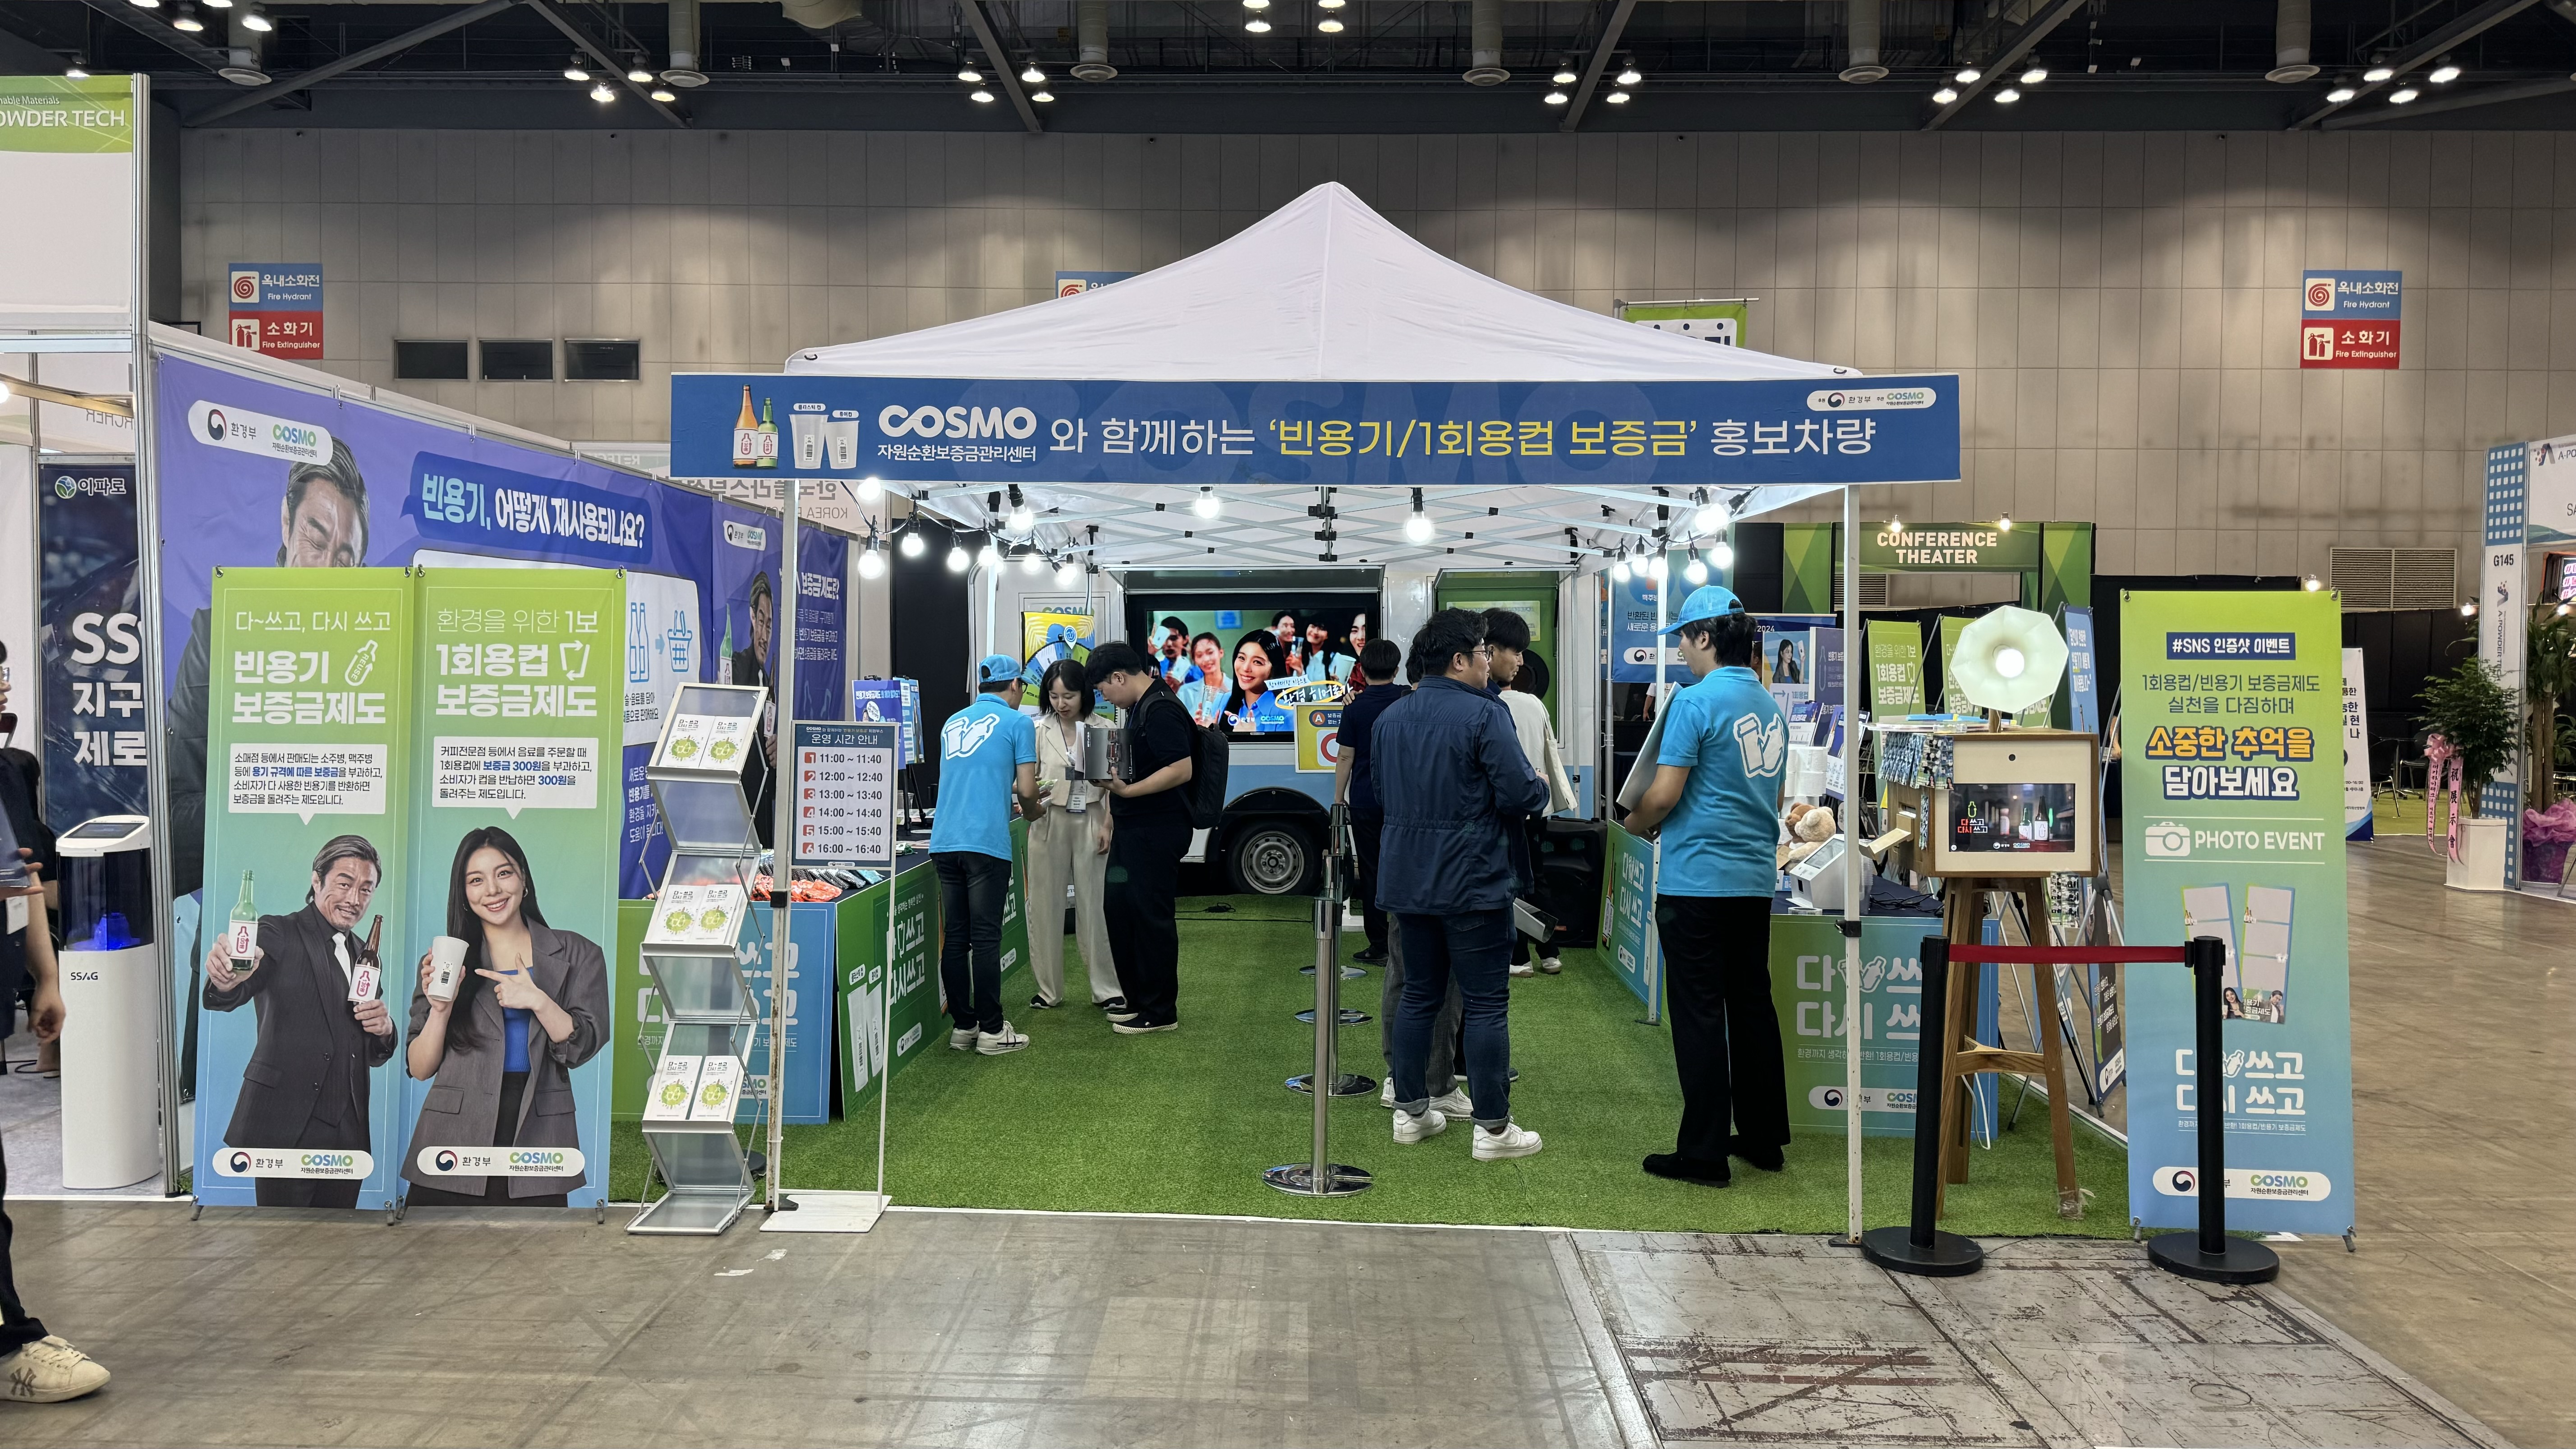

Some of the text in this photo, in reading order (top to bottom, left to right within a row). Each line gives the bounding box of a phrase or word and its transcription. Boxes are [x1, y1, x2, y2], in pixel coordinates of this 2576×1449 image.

[22, 95, 60, 105] Materials
[72, 110, 125, 127] TECH
[261, 274, 320, 288] 옥내소화전
[2337, 281, 2399, 295] 옥내소화전
[283, 293, 312, 302] Hydrant
[2359, 301, 2390, 309] Hydrant
[267, 322, 313, 337] 소화기
[2341, 330, 2390, 345] 소화기
[277, 341, 320, 350] Extinguisher
[2351, 350, 2397, 359] Extinguisher
[1886, 391, 1924, 400] COSMO
[879, 405, 1037, 439] COSMO
[230, 422, 257, 440] 환경부
[272, 424, 317, 447] COSMO
[1050, 418, 1088, 453] 와
[1101, 418, 1255, 455] 함께하는
[1710, 418, 1877, 456] 홍보차량
[272, 442, 317, 458] 자원순환보증금관리센터
[878, 444, 1036, 463] 자원순환보증금관리센터
[78, 477, 127, 496] 이파로
[422, 473, 645, 549] 빈용기, 어떻게 재사용되나요?
[1877, 532, 1997, 547] CONFERENCE
[1895, 549, 1978, 564] THEATER
[2493, 554, 2514, 567] G145
[313, 611, 347, 631] 다시
[354, 612, 391, 631] 쓰고
[437, 608, 598, 633] 환경을 위한 1보
[1874, 644, 1894, 658] 환경을
[1894, 645, 1906, 658] 위한
[2172, 638, 2291, 653] #SNS 인증샷 이벤트
[436, 643, 549, 676] 1회용컵
[234, 650, 329, 684] 빈용기
[350, 653, 369, 681] REUSE
[1876, 663, 1906, 682] 1회용컵
[2142, 673, 2320, 693] 1회용컵/빈용기 보증금제도
[73, 682, 143, 718] 지구
[436, 684, 597, 717] 보증금제도
[2168, 696, 2295, 714] 실천을 다짐하며
[232, 691, 386, 725] 보증금제도
[1314, 714, 1323, 723] A
[812, 734, 878, 745] 운영 시간 안내
[2147, 727, 2312, 759] 소중한 추억을
[74, 731, 147, 766] 제로
[440, 746, 587, 758] 커피전문점 등에서 음료를 주문할 때
[234, 753, 373, 764] 소매점 등에서 판매되는 소주병, 맥주병
[820, 754, 882, 764] 11:00 11:40
[234, 767, 382, 778] 등에 용기 규격에 따른 보증금을 부과하고,
[440, 760, 592, 772] 1회용컵에 보증금 300원을 부과하고,
[440, 774, 576, 786] 소비자가 컵을 반납하면 300원을
[629, 766, 644, 782] 새로운
[819, 772, 883, 782] 12:00 12:40
[234, 780, 370, 791] 소비자가 다 사용한 빈용기를 반환하면
[2165, 766, 2297, 797] 담아보세요
[233, 794, 344, 805] 보증금을 돌려주는 제도입니다.
[440, 788, 526, 800] 돌려주는 제도입니다.
[819, 790, 882, 800] 13:00 13:40
[819, 808, 882, 818] 14:00 14:40
[818, 826, 881, 836] 15:00 15:40
[2194, 830, 2325, 851] PHOTO EVENT
[818, 844, 881, 854] 16:00 16:40
[1797, 955, 1923, 994] 다 쓰
[1886, 1004, 1921, 1040] 쓰
[1797, 1048, 1826, 1059] 환경까지
[2245, 1050, 2305, 1080] 쓰고
[2245, 1086, 2306, 1115] 쓰고
[2278, 1123, 2306, 1132] 보증금제도
[255, 1157, 284, 1169] 환경부
[301, 1154, 353, 1166] COSMO
[462, 1155, 492, 1167] 환경부
[509, 1152, 564, 1164] COSMO
[300, 1167, 354, 1175] 자원순환보증금관리센터
[509, 1165, 564, 1173] 자원순환보증금관리센터
[2250, 1174, 2309, 1188] COSMO
[2250, 1187, 2309, 1196] 자원순환보증금관리센터
